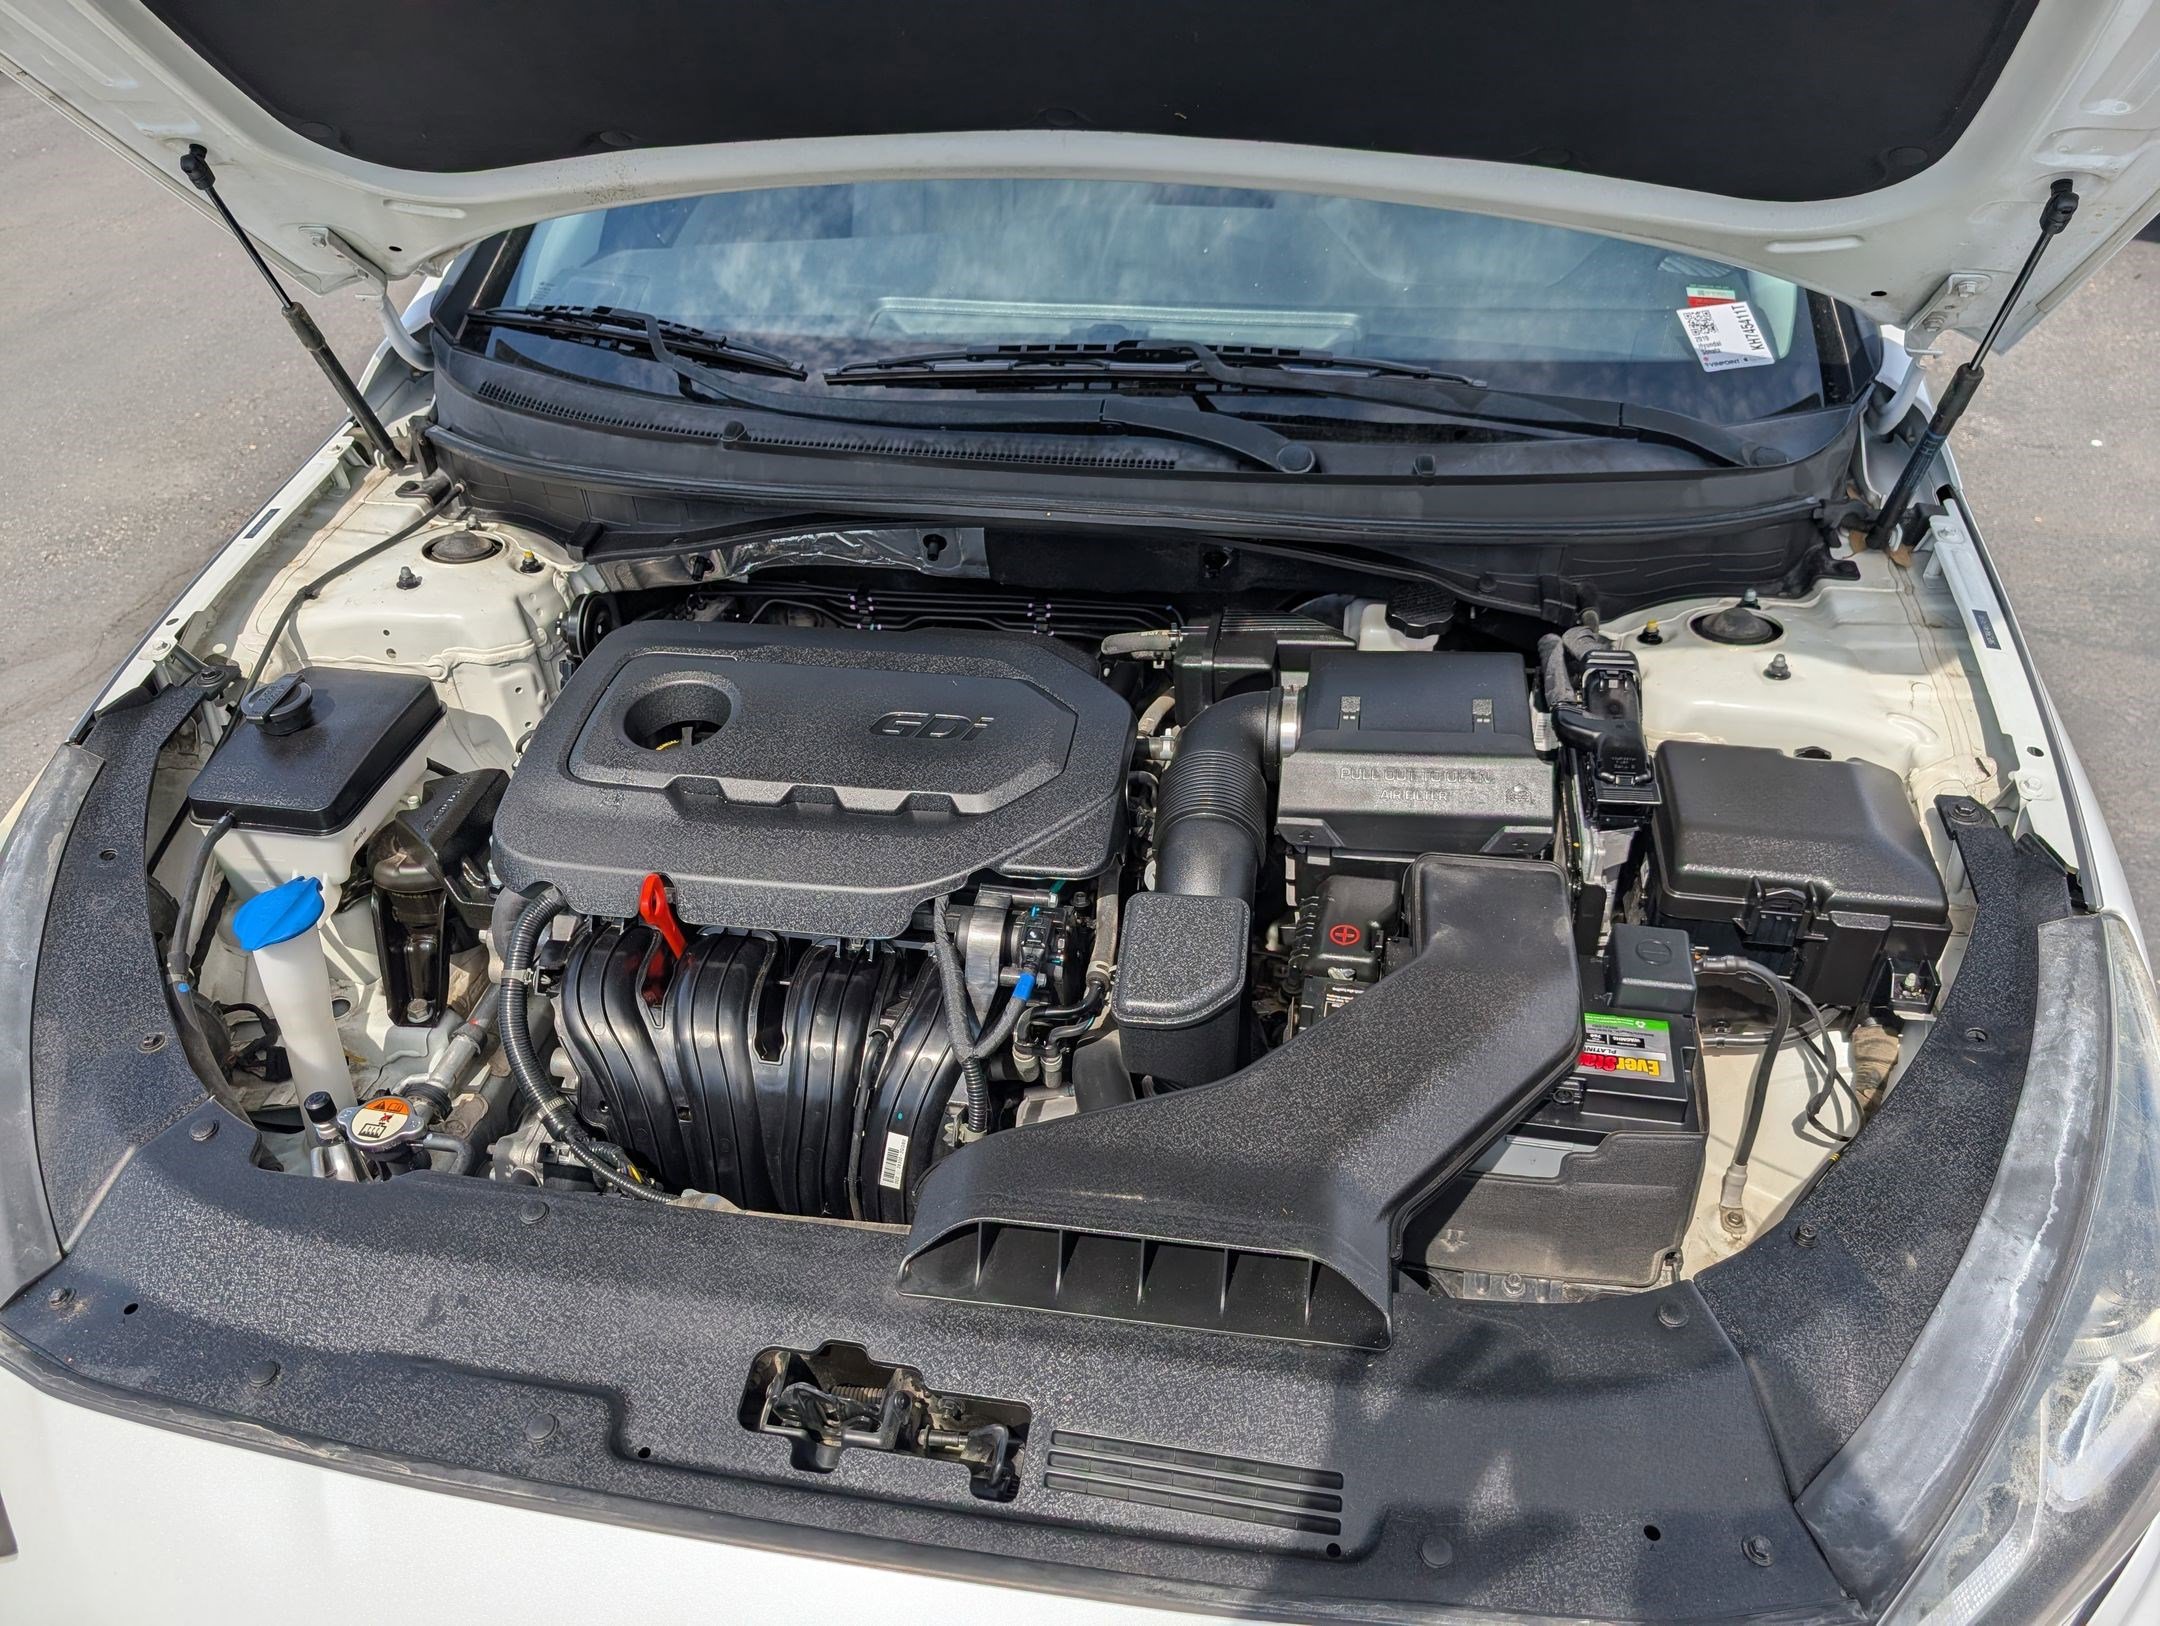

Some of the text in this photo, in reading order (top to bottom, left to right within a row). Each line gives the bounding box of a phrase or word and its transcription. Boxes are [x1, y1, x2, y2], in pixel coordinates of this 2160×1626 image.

[1340, 767, 1494, 784] PULL OUT TO OPEN
[1379, 789, 1449, 802] AIR FILTER
